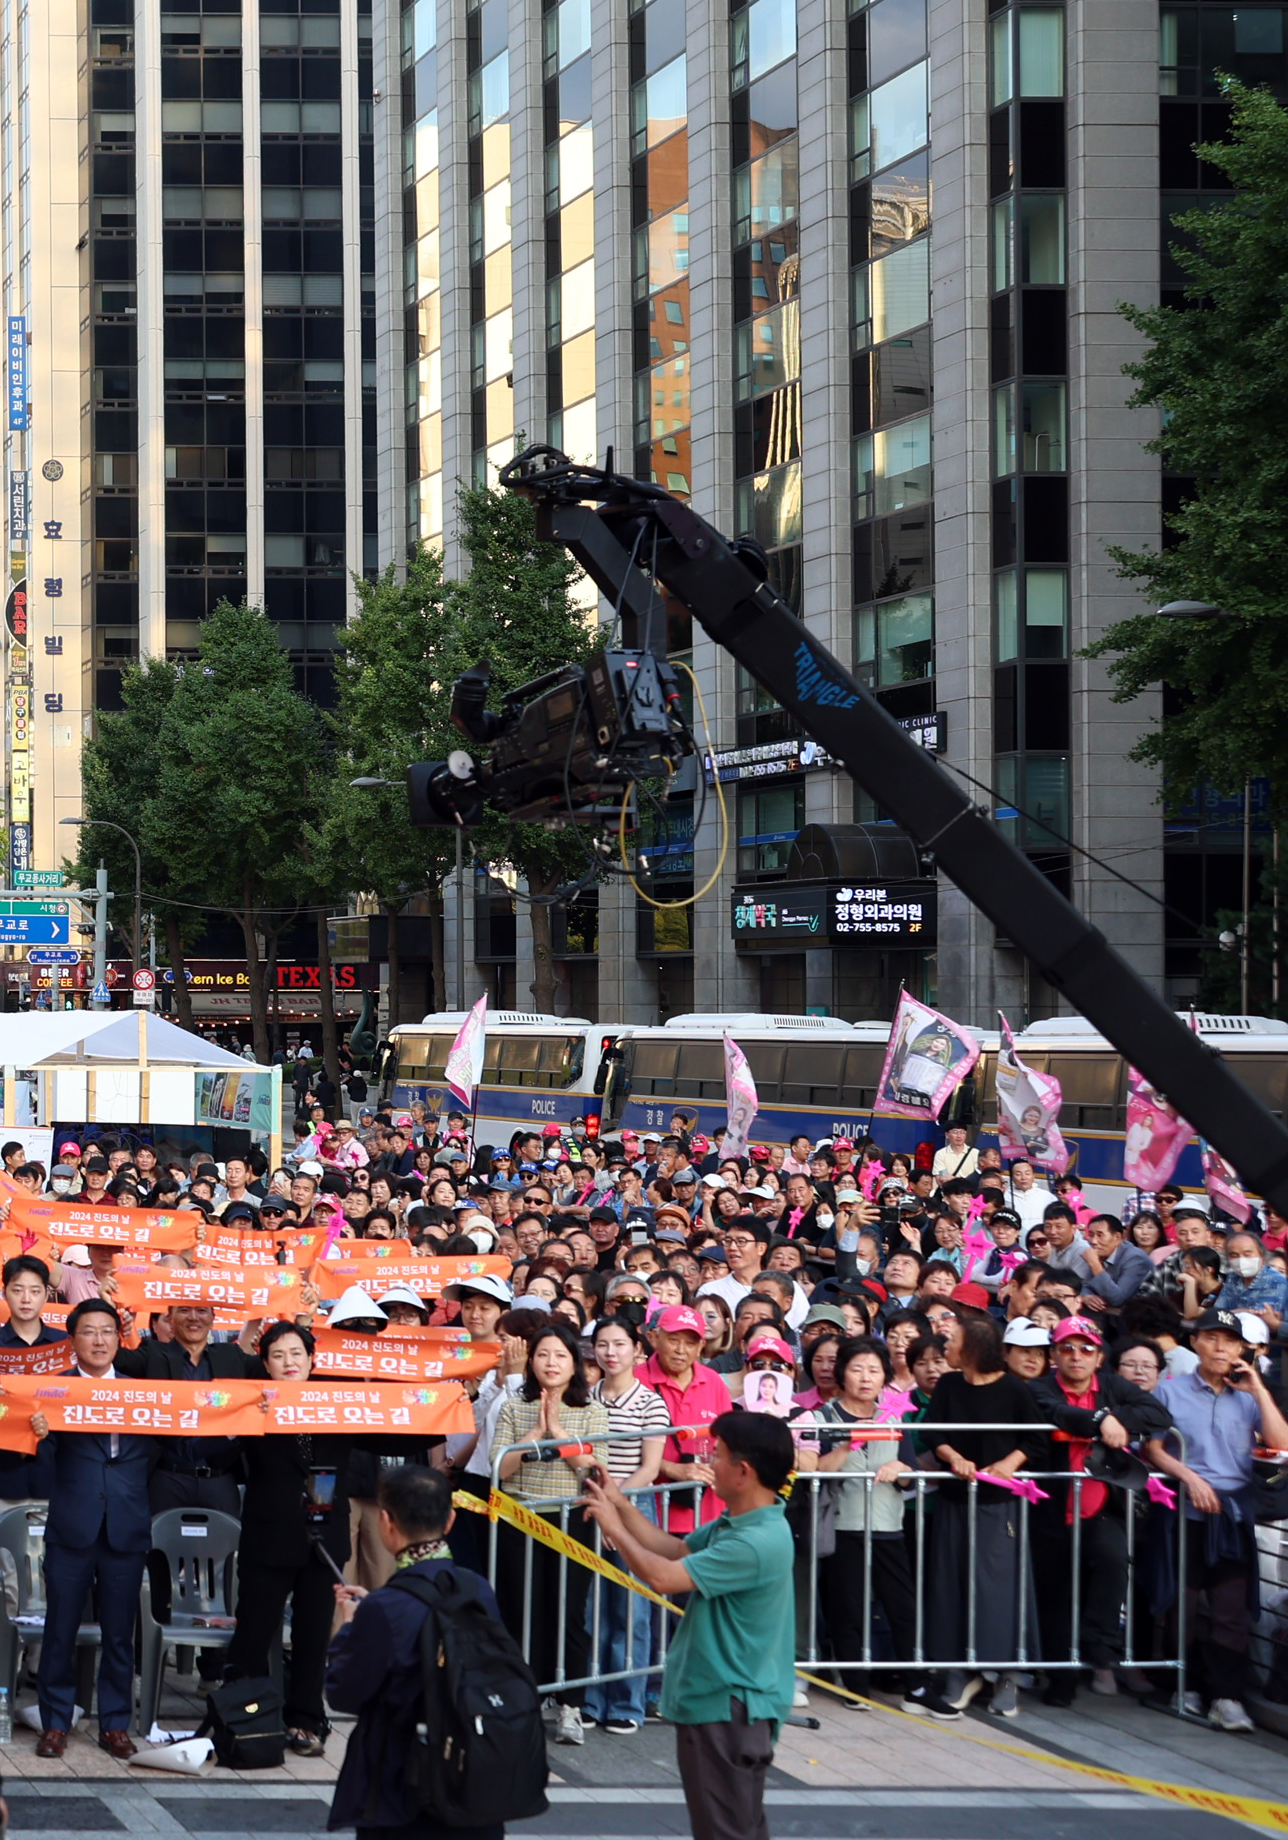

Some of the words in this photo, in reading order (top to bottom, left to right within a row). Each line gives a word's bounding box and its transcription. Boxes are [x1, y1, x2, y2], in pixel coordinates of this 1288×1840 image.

[12, 321, 23, 412] 미래이비인후과
[13, 484, 26, 531] 서린치과
[13, 591, 27, 634] BAR
[43, 519, 63, 713] 효령빌딩
[793, 642, 862, 710] TRIANGLE
[912, 715, 938, 728] CLINIC
[13, 839, 27, 848] 사랑
[18, 873, 59, 884] 무교동사거리
[853, 889, 887, 902] 우리본
[39, 904, 56, 913] 시청
[835, 904, 922, 921] 정형외과의원
[836, 922, 901, 933] 02-755-8575
[909, 923, 922, 932] 2F
[40, 967, 70, 979] BEER
[216, 973, 234, 985] Ice
[236, 973, 250, 985] Ba
[36, 976, 74, 988] COFFEE
[532, 1100, 556, 1115] POLICE
[646, 1109, 664, 1127] 경찰
[833, 1123, 869, 1140] POLICE
[69, 1211, 92, 1221] 2024
[93, 1213, 120, 1224] 진도의
[121, 1215, 131, 1225] 날
[48, 1222, 95, 1238] 진도로
[98, 1226, 130, 1240] 오는
[134, 1228, 151, 1242] 길
[300, 1391, 330, 1402] 2024
[332, 1391, 366, 1403] 진도의
[369, 1391, 381, 1404] 날
[274, 1406, 338, 1425] 진도로
[344, 1407, 384, 1424] 오는
[390, 1407, 410, 1425] 길
